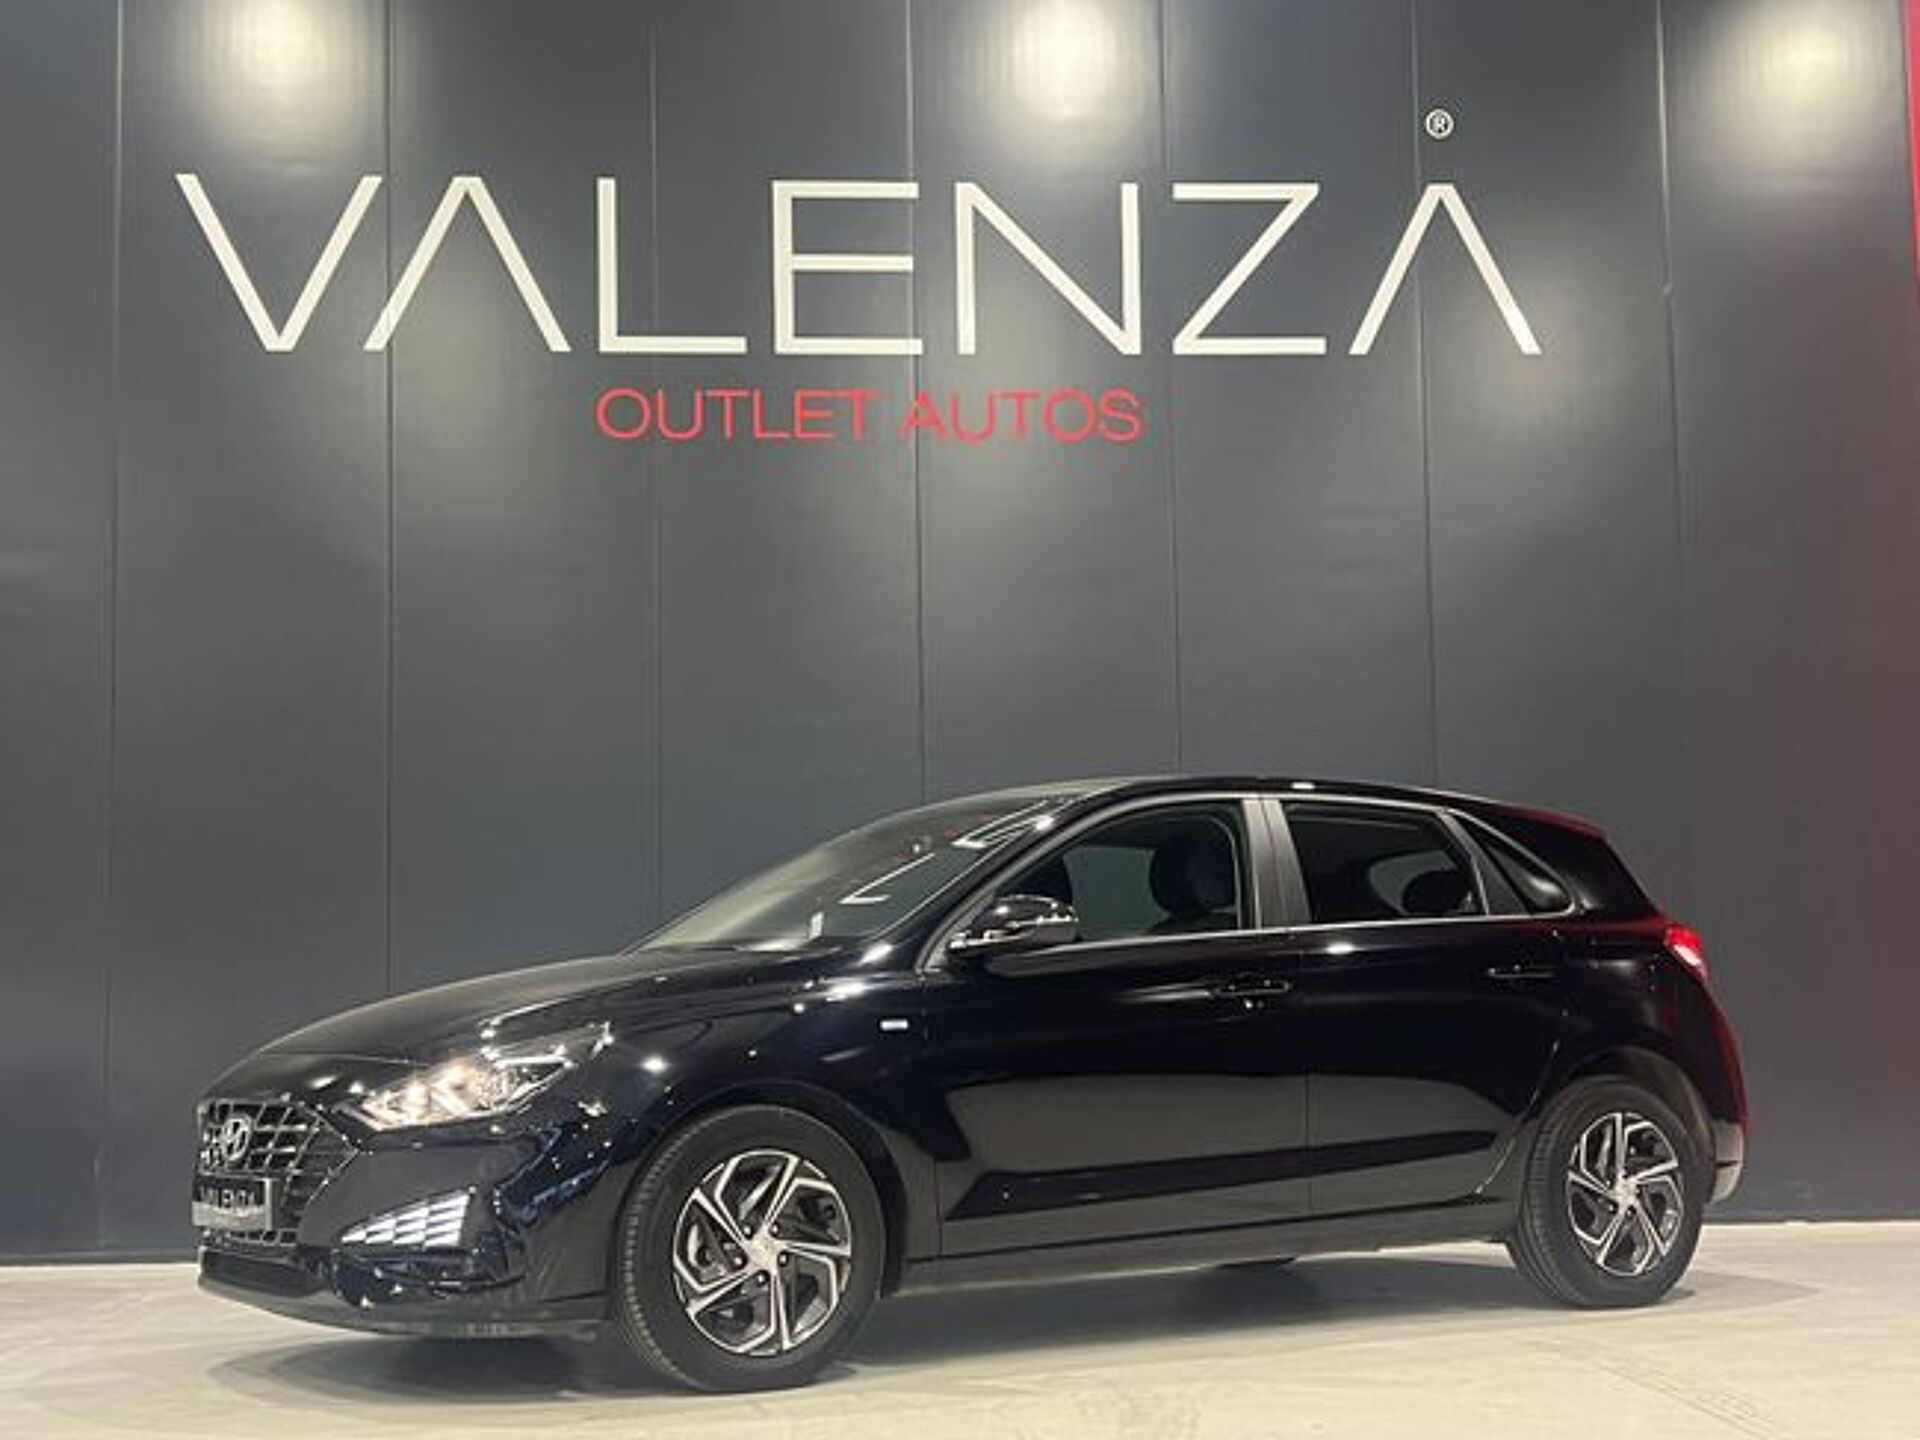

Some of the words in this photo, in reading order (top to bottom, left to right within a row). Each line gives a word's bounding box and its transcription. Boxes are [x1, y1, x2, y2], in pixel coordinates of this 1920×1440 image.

[175, 172, 1541, 356] VALENZA
[596, 387, 882, 441] OUTLET
[901, 387, 1144, 444] AUTOS
